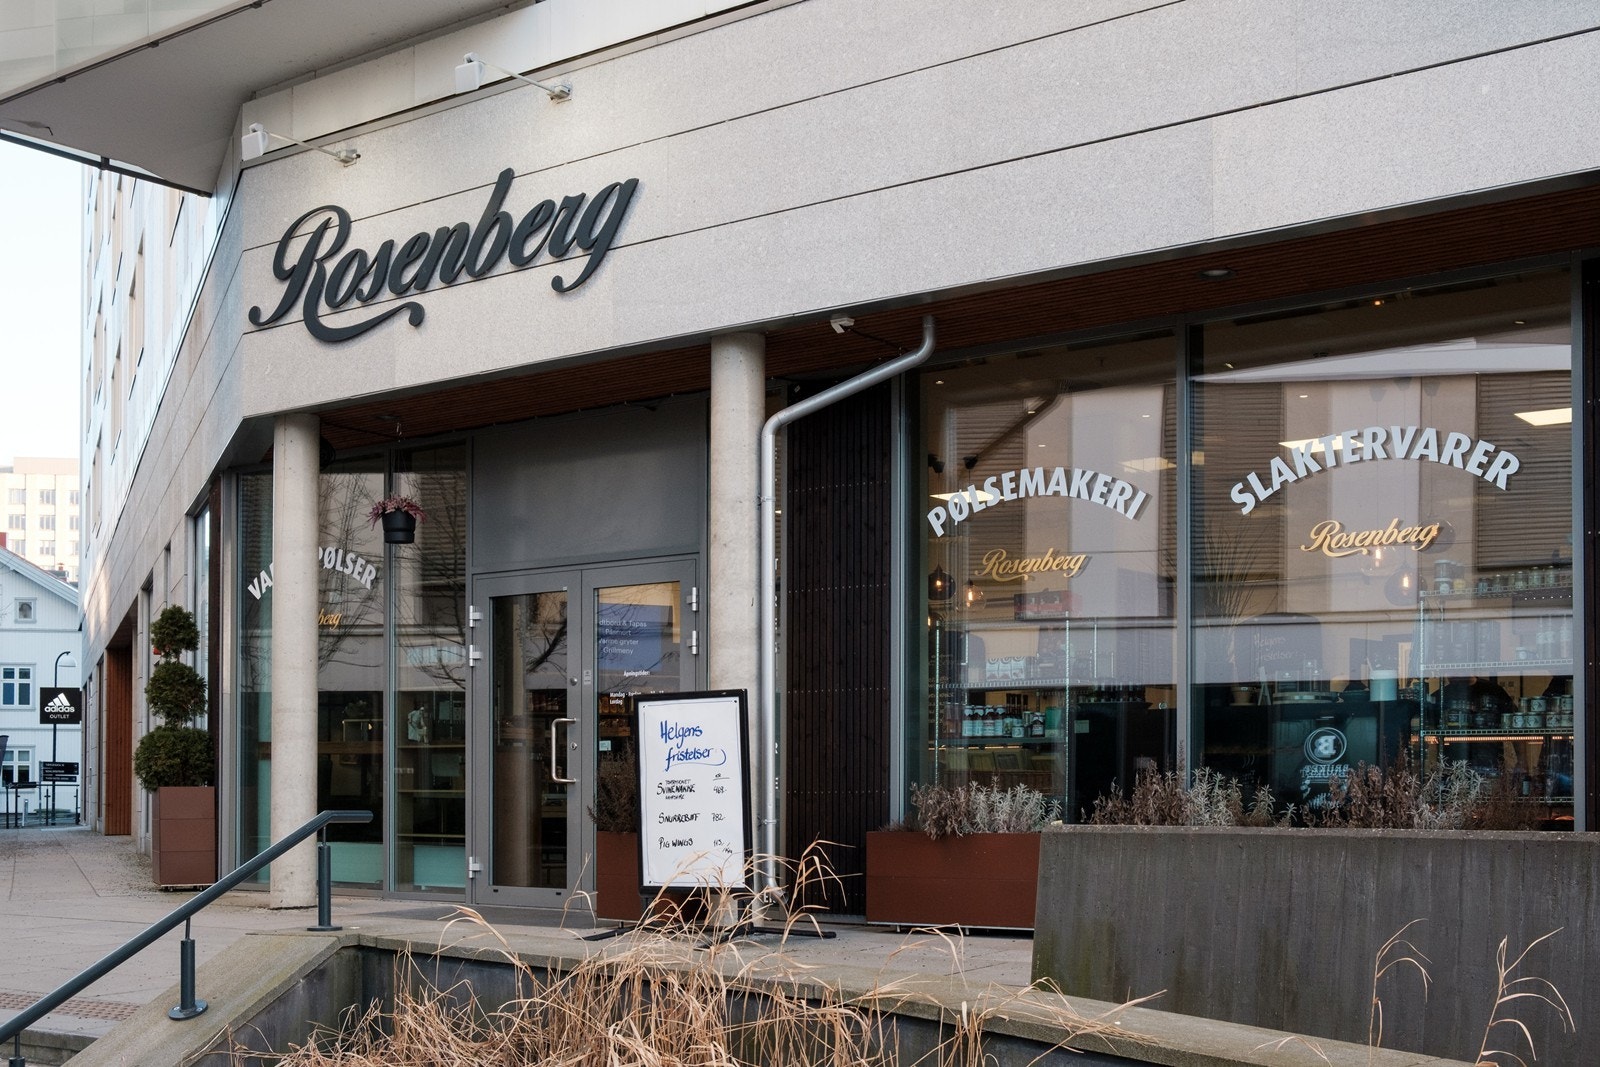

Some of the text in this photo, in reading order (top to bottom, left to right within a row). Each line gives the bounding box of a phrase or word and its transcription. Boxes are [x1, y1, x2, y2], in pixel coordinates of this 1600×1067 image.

[247, 167, 640, 344] Rosenberg
[1230, 425, 1520, 516] SLAKTERVARER
[926, 467, 1147, 538] PØLSEMAKERI
[1300, 518, 1440, 558] Rosenberg
[247, 561, 274, 600] VA
[974, 547, 1087, 582] Rosenberg
[629, 620, 648, 628] Tapas
[44, 705, 75, 713] adidas
[660, 720, 703, 749] Helgens
[664, 747, 714, 772] fristelser
